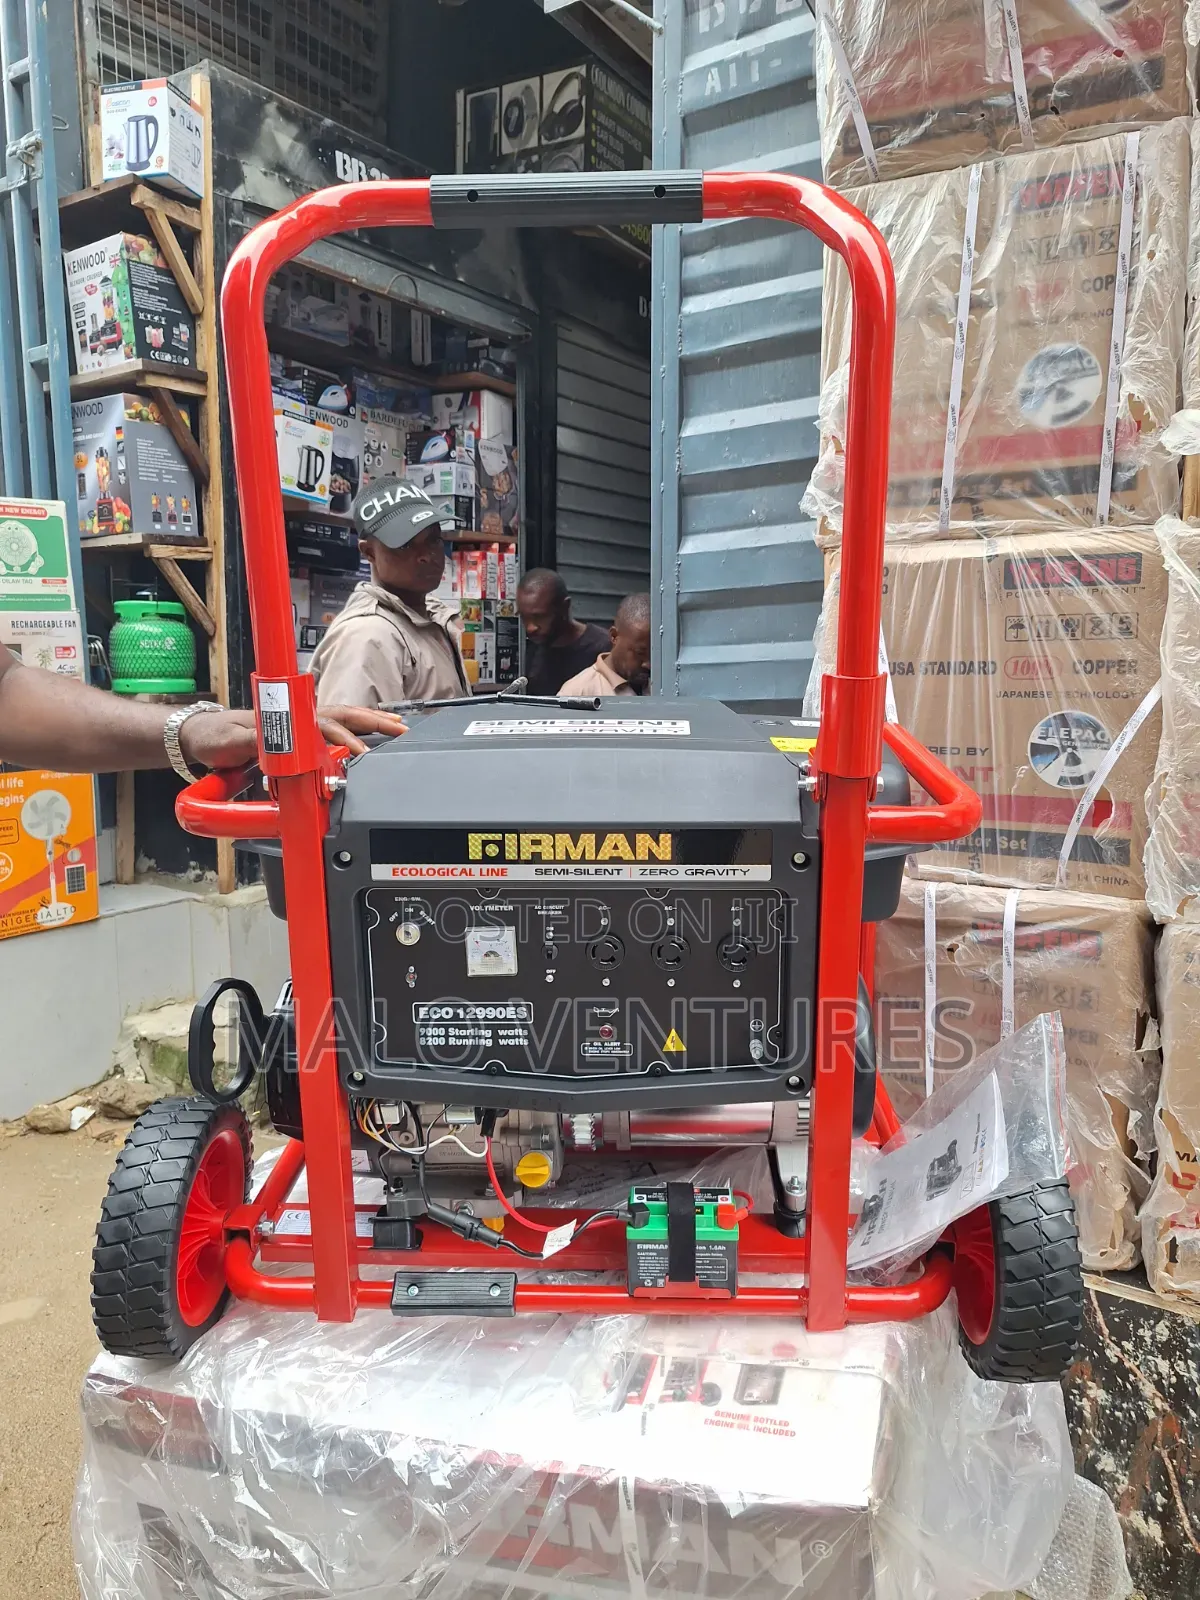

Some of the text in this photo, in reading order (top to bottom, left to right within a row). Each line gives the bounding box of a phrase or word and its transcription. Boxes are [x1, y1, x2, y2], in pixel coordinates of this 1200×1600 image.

[67, 250, 105, 275] KENWOOD
[310, 409, 349, 428] ENWOOD
[11, 620, 77, 628] RECHARGEABLE FAN
[920, 660, 997, 676] STANDARD
[1072, 659, 1138, 676] COPPER
[996, 690, 1053, 699] JAPANESE
[966, 747, 990, 757] BY
[7, 777, 24, 788] life
[468, 833, 672, 860] FIRMAN
[1001, 836, 1027, 850] Set
[392, 868, 751, 876] ECOLOGICAL LINE SEMI-SILENT ZERO GRAVITY
[1094, 875, 1130, 887] CHINA
[1, 905, 76, 927] NIGERIA LTD
[418, 1007, 528, 1019] ECO 12990ES
[419, 1028, 528, 1037] 9000 Starting watts
[419, 1037, 529, 1047] 8200 Running watts
[715, 1409, 790, 1428] GENUINE BOTTLED
[704, 1418, 735, 1429] ENGINE
[753, 1425, 796, 1438] INCLUDED
